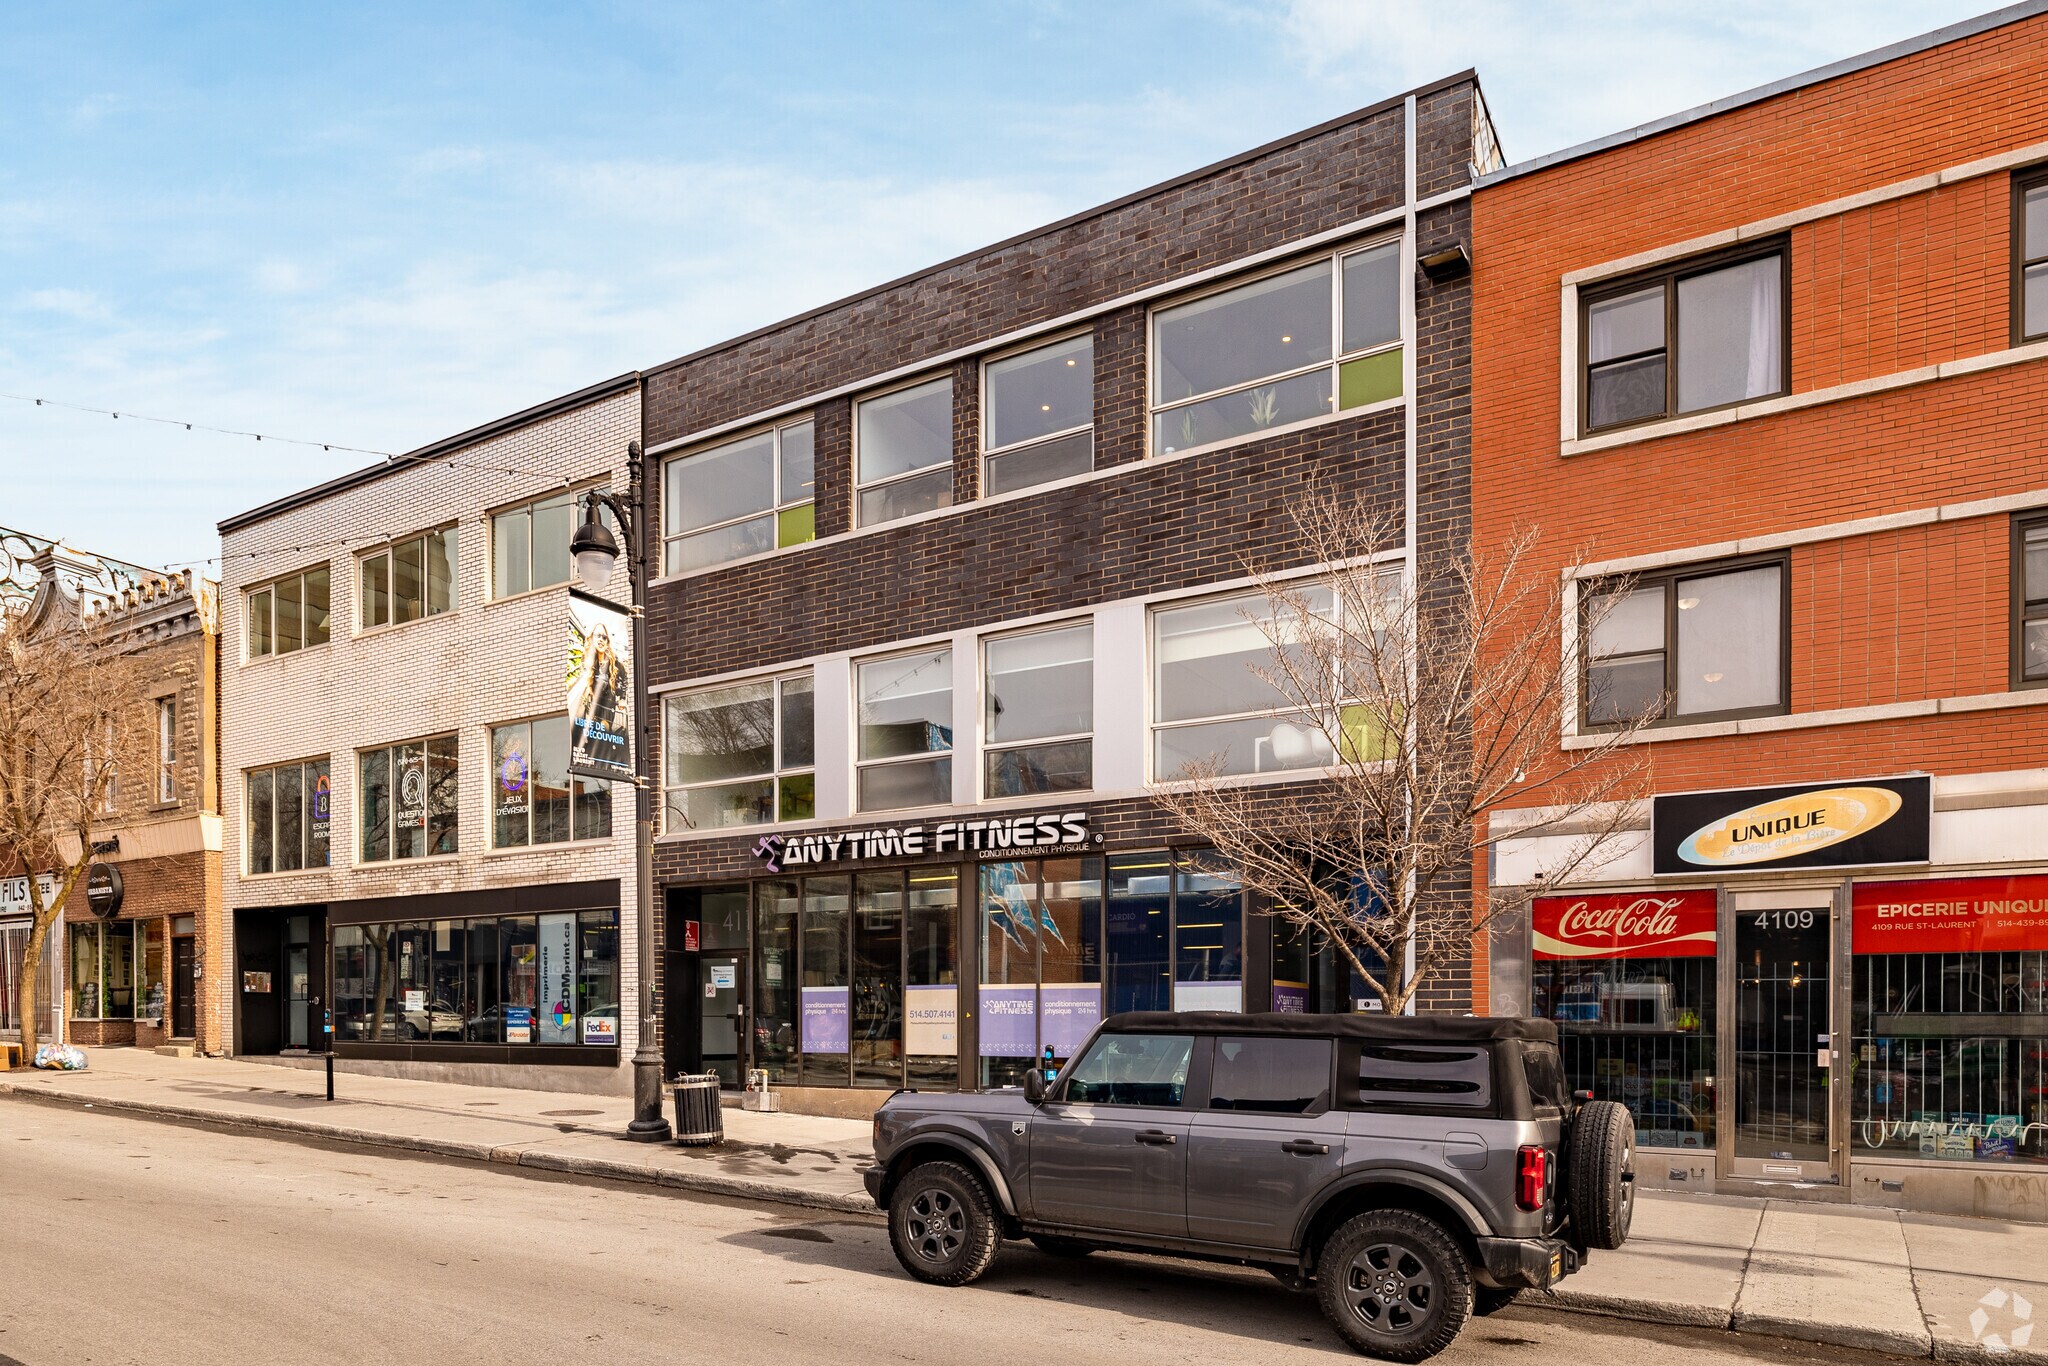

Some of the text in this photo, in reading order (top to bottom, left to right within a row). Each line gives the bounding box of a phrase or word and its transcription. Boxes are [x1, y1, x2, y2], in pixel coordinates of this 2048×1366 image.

[575, 717, 606, 731] LIBRE DE
[583, 726, 625, 745] DÉCOUVRIR
[503, 795, 522, 805] JEUX
[496, 805, 528, 816] D'ÉVASIO
[1732, 809, 1826, 843] UNIQUE
[782, 812, 1086, 865] ANYTIME FITNESS
[1775, 838, 1787, 848] de
[1792, 835, 1801, 844] la
[979, 843, 1089, 859] CONDITIONNEMENT PHYSIQUE
[1877, 899, 2048, 918] EPICERIE UNIQU
[1558, 897, 1685, 938] Coca-Cola
[1754, 910, 1814, 930] 4109
[1871, 923, 1893, 931] 4109
[1894, 922, 1914, 930] RUE
[1916, 921, 1977, 929] ST-LAURENT
[561, 922, 571, 1011] CDMprint.ca
[993, 1000, 1033, 1008] ANYTIME
[1044, 1007, 1071, 1015] physique
[909, 1010, 955, 1018] 514.507.4141
[586, 1020, 611, 1032] FedEx
